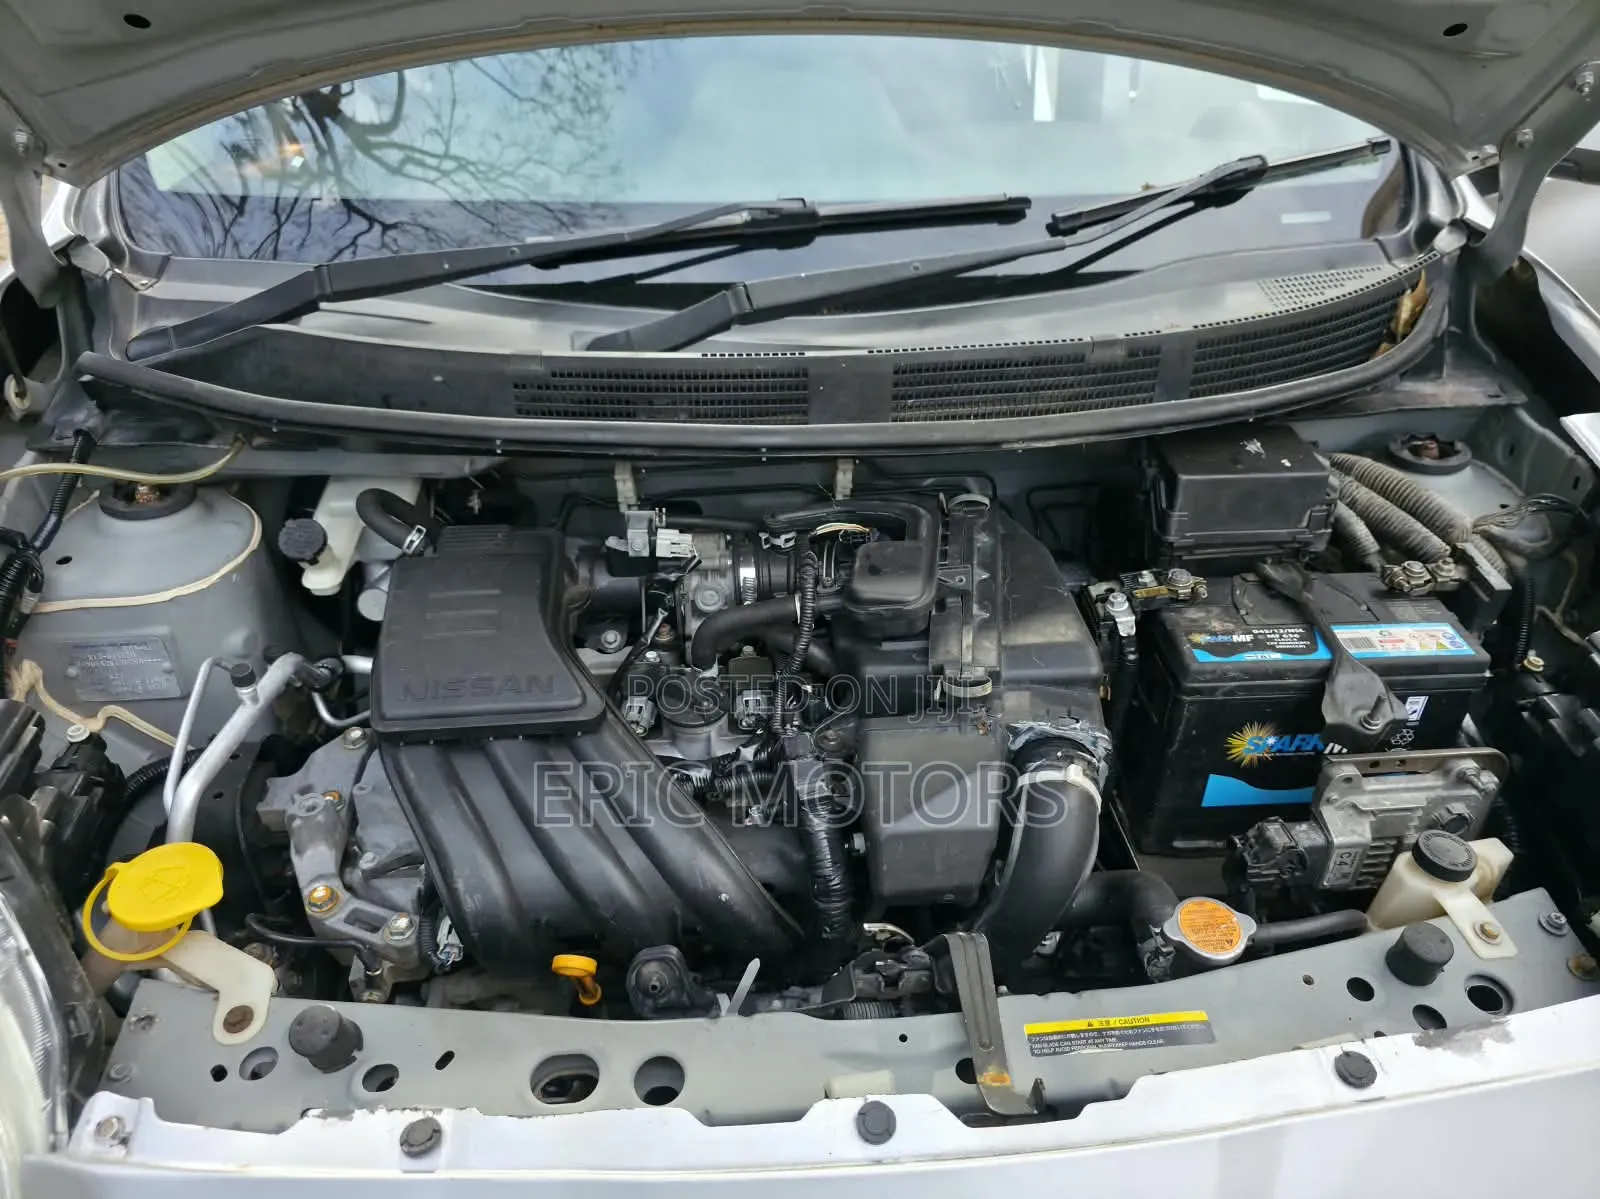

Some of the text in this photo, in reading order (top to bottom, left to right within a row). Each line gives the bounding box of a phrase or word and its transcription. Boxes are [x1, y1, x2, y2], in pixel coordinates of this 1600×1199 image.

[402, 673, 555, 702] NISSAN
[1243, 733, 1326, 754] SPARK
[1118, 1016, 1151, 1026] CAUTION
